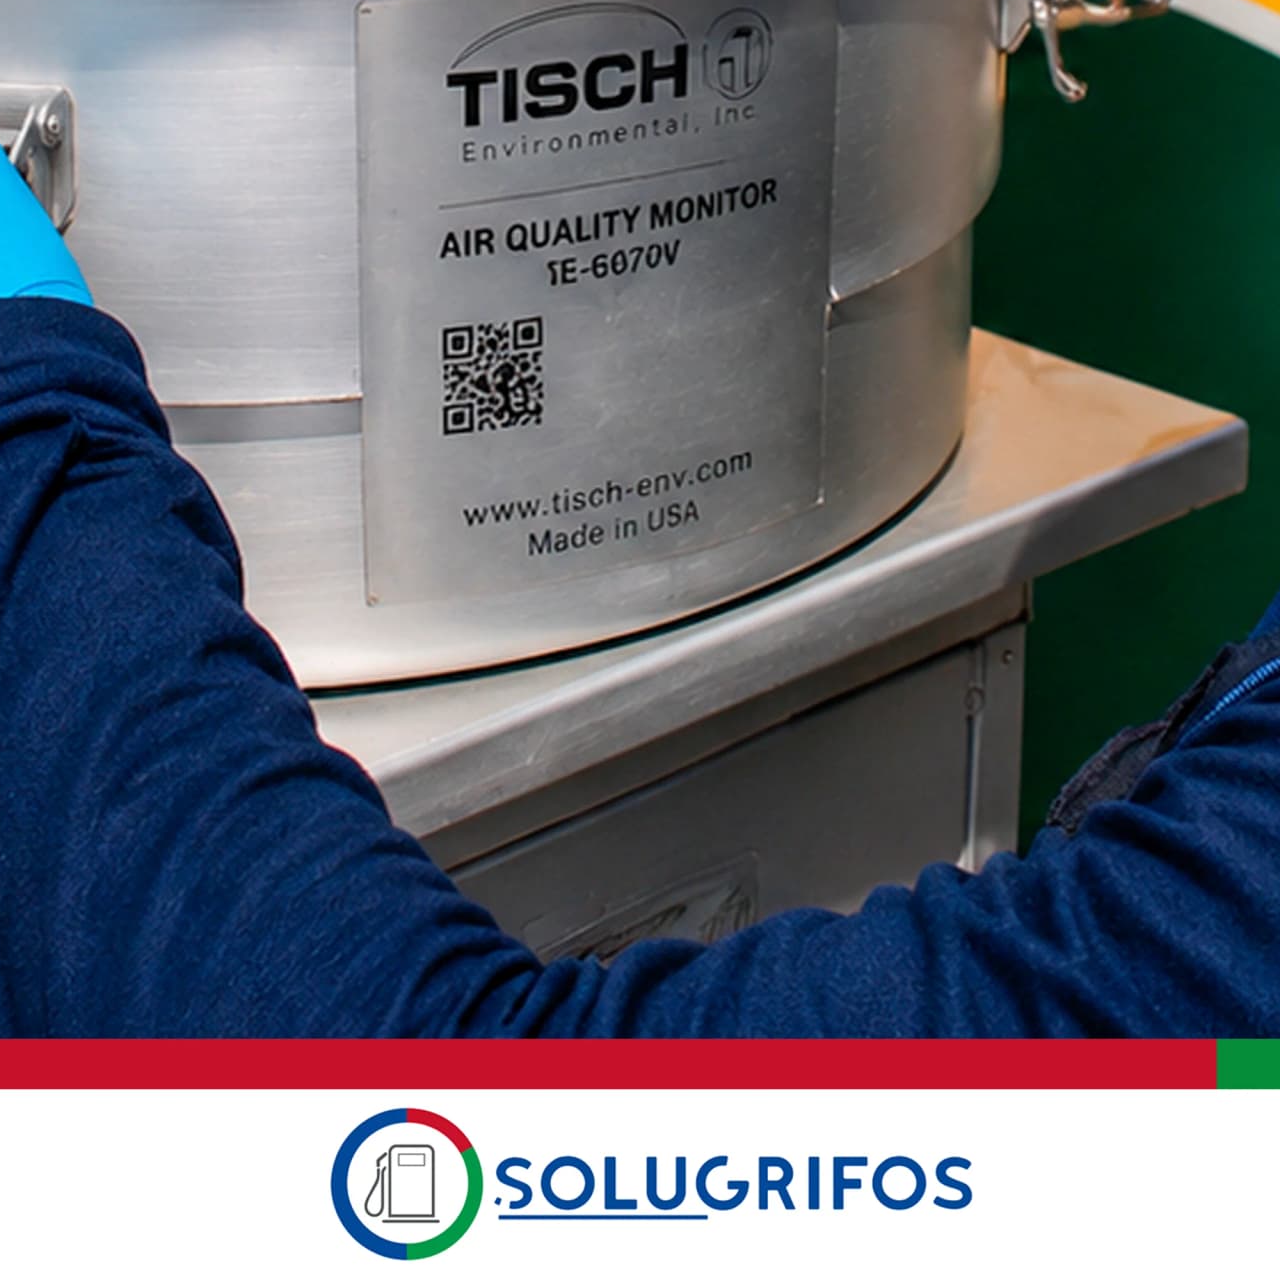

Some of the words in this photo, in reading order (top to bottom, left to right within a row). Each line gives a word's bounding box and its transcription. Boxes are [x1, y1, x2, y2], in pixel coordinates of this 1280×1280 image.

[447, 43, 688, 127] TISCH
[440, 227, 495, 259] AIR
[506, 205, 641, 253] QUALITY
[650, 177, 777, 230] MONITOR
[463, 451, 753, 527] www.tisch-env.com
[527, 523, 604, 556] Made
[614, 517, 638, 540] in
[647, 500, 699, 532] USA
